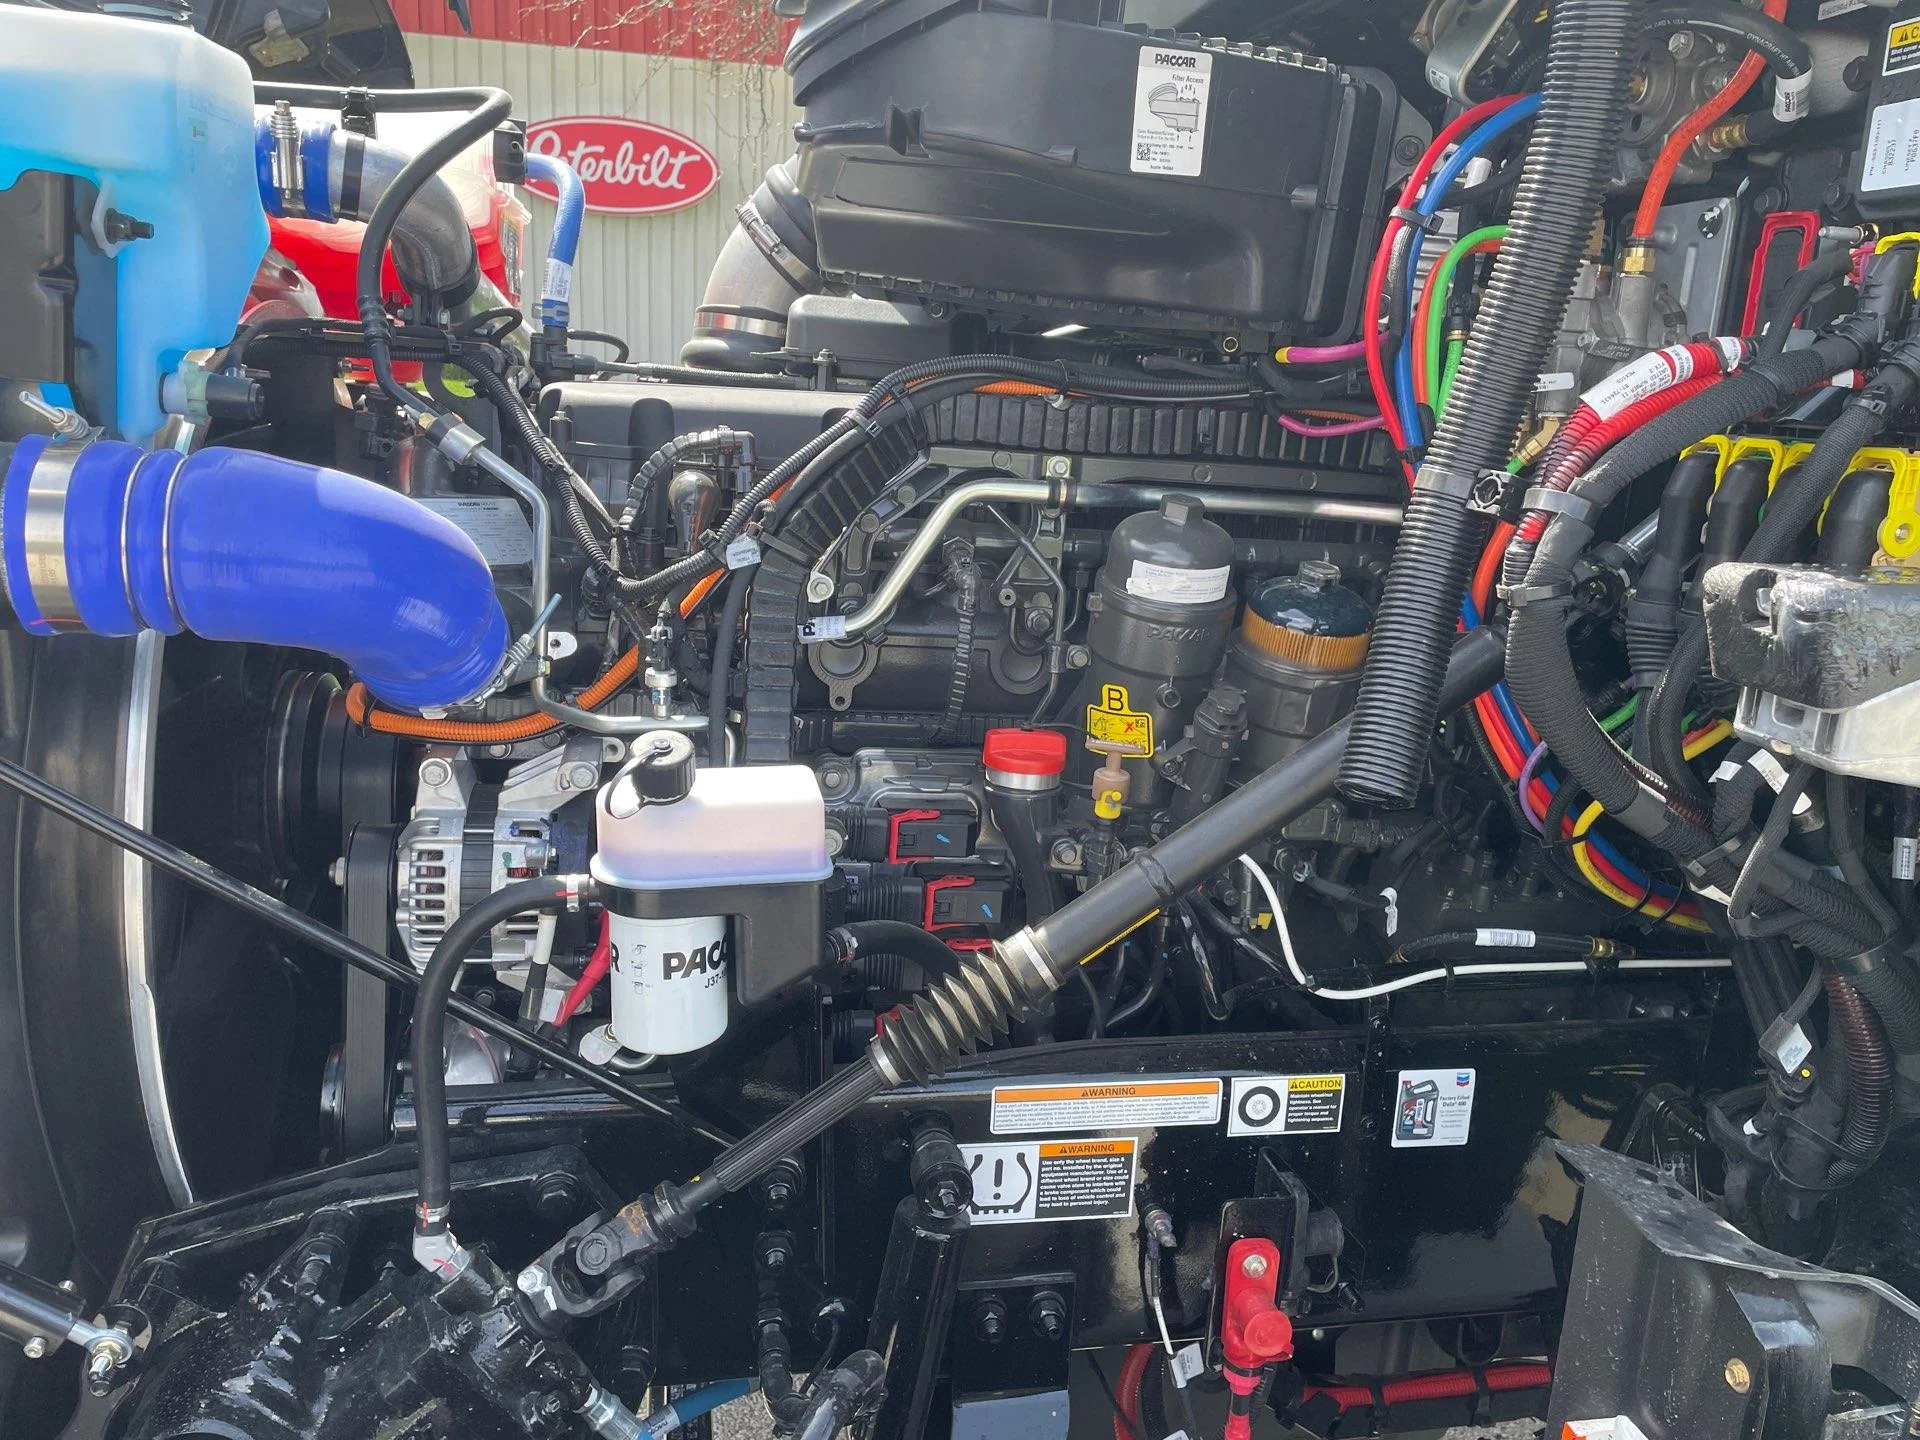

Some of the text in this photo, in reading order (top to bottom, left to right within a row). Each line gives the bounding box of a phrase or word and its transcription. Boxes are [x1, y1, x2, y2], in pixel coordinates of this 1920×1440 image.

[1154, 53, 1196, 68] PACCAR
[1172, 74, 1204, 84] Filter Access
[530, 130, 701, 190] Pterbilt
[1108, 688, 1124, 712] B
[1298, 1080, 1341, 1089] CAUTION
[1088, 1087, 1136, 1098] WARNING
[1067, 1144, 1115, 1154] WARNING
